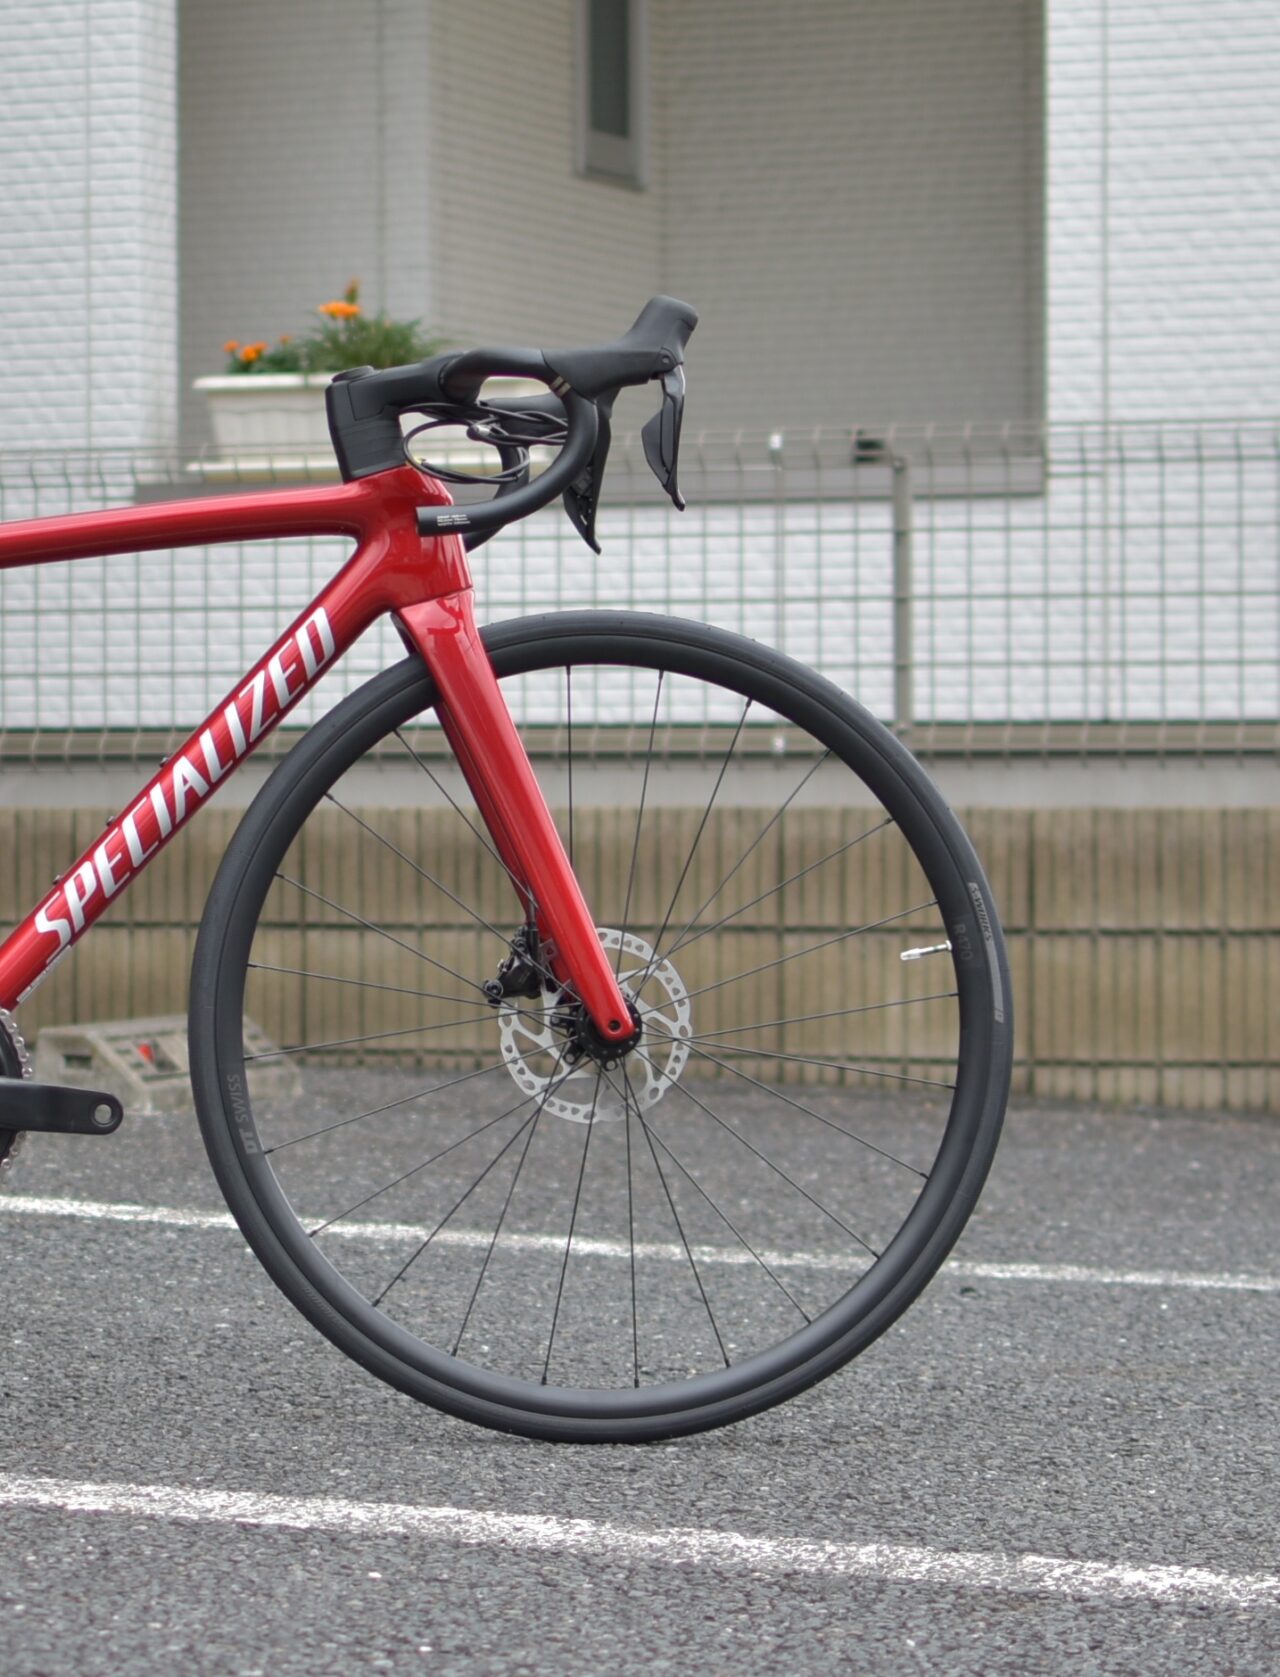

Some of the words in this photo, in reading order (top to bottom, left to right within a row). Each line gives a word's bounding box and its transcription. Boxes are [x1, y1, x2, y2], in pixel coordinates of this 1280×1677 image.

[34, 606, 336, 963] SPECIALIZED
[955, 923, 974, 960] R470
[227, 1073, 249, 1123] SWISS
[239, 1128, 258, 1154] DT
